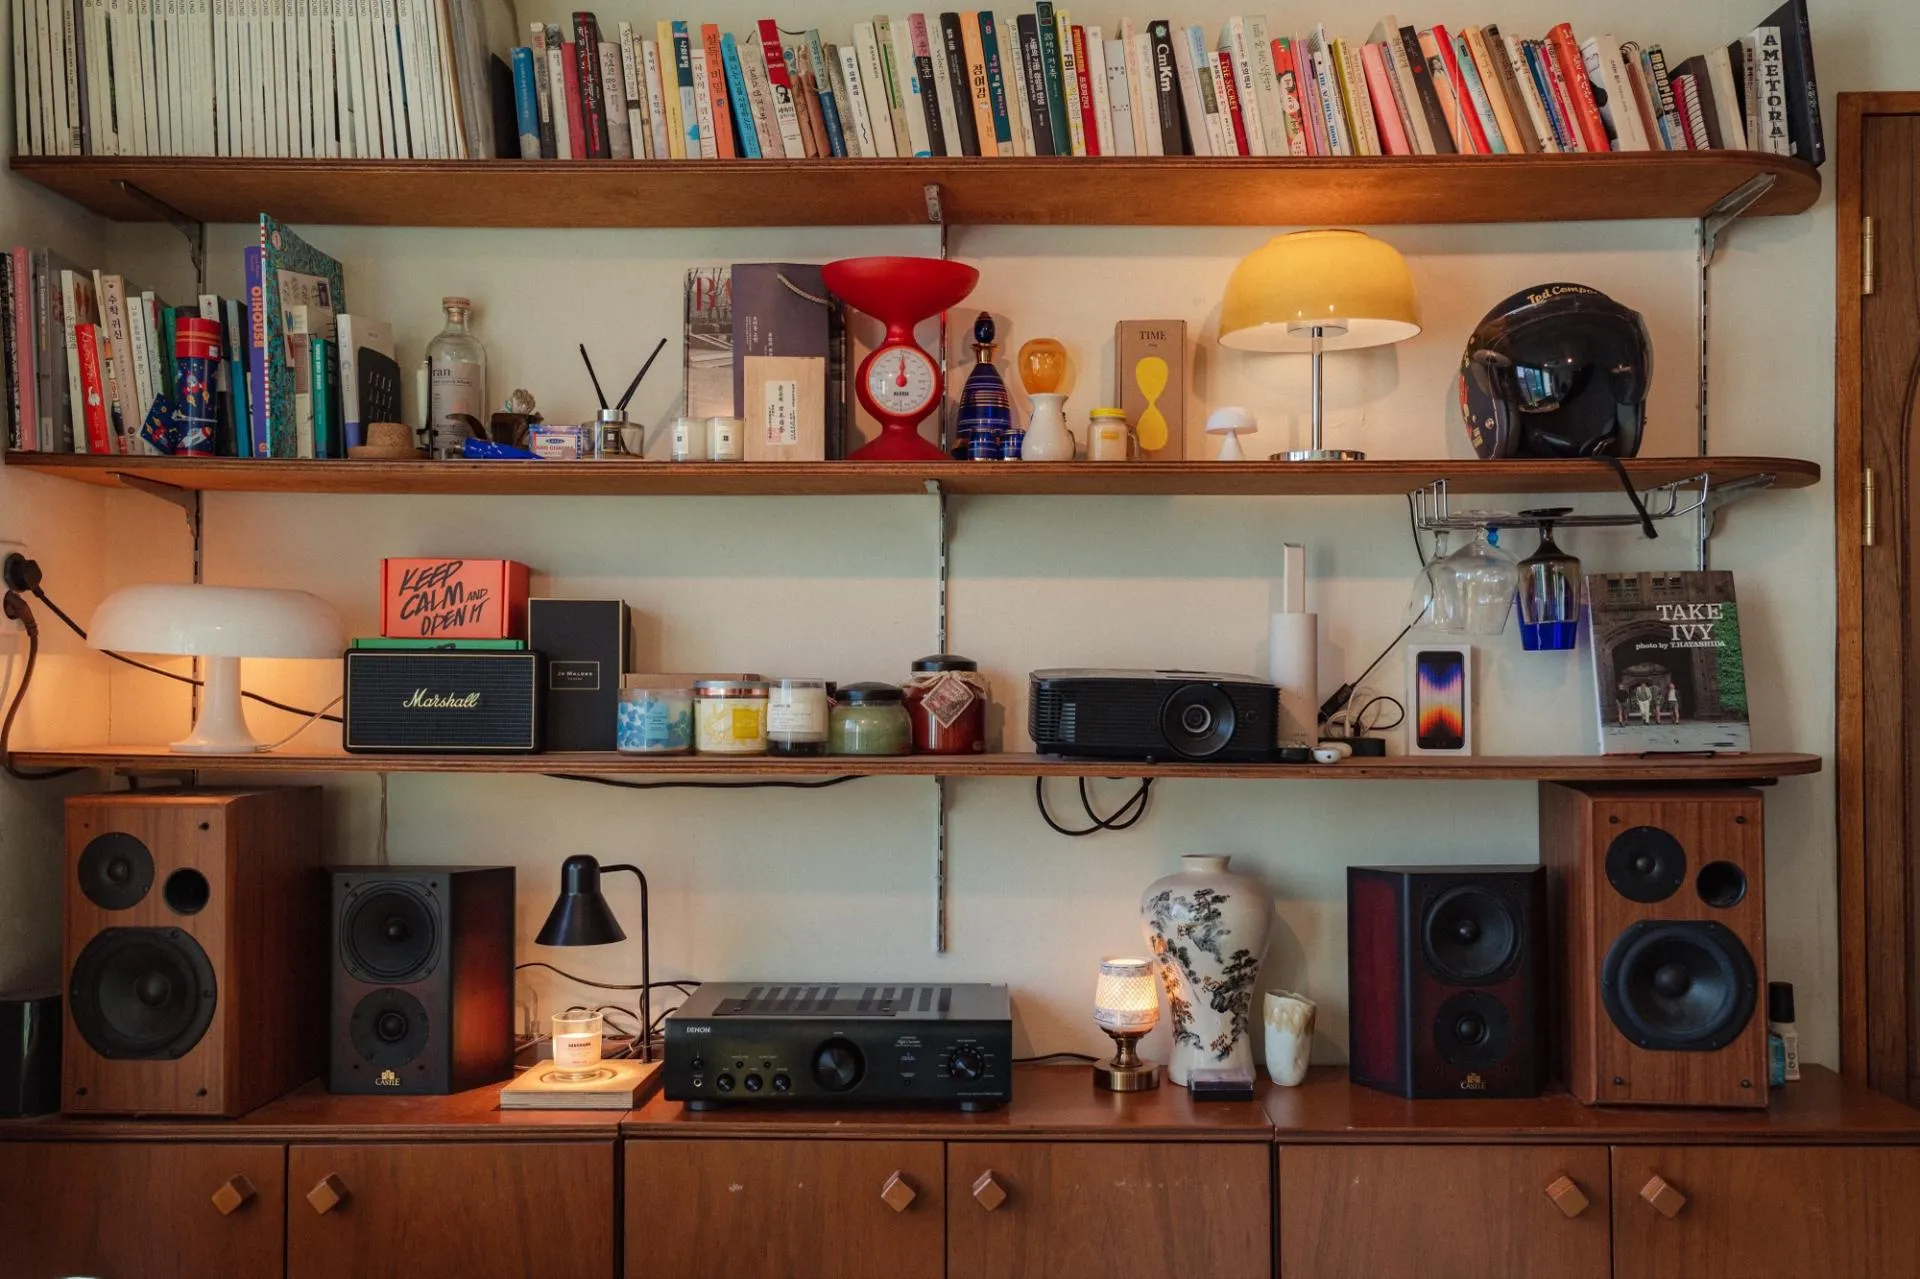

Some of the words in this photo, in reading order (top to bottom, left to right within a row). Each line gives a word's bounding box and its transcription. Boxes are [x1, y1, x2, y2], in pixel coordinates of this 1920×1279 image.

[1063, 54, 1075, 71] FBI
[1156, 43, 1173, 93] CmKm
[1221, 61, 1231, 79] THE
[1650, 53, 1676, 113] memories
[1762, 34, 1785, 139] AMETORA
[1225, 78, 1239, 111] SECRET
[106, 294, 120, 317] 수학
[110, 318, 123, 341] 귀신
[1139, 330, 1167, 341] TIME
[398, 560, 464, 597] KEEP
[399, 581, 464, 620] CALM
[466, 588, 488, 603] AND
[420, 604, 467, 637] OPEN
[469, 598, 491, 624] IT
[1656, 603, 1724, 622] TAKE
[1670, 624, 1714, 642] IVY
[1635, 642, 1658, 651] photo
[1658, 642, 1669, 651] by
[402, 688, 481, 709] Marshall
[685, 1026, 712, 1034] DENON
[374, 1077, 401, 1087] CASTLE
